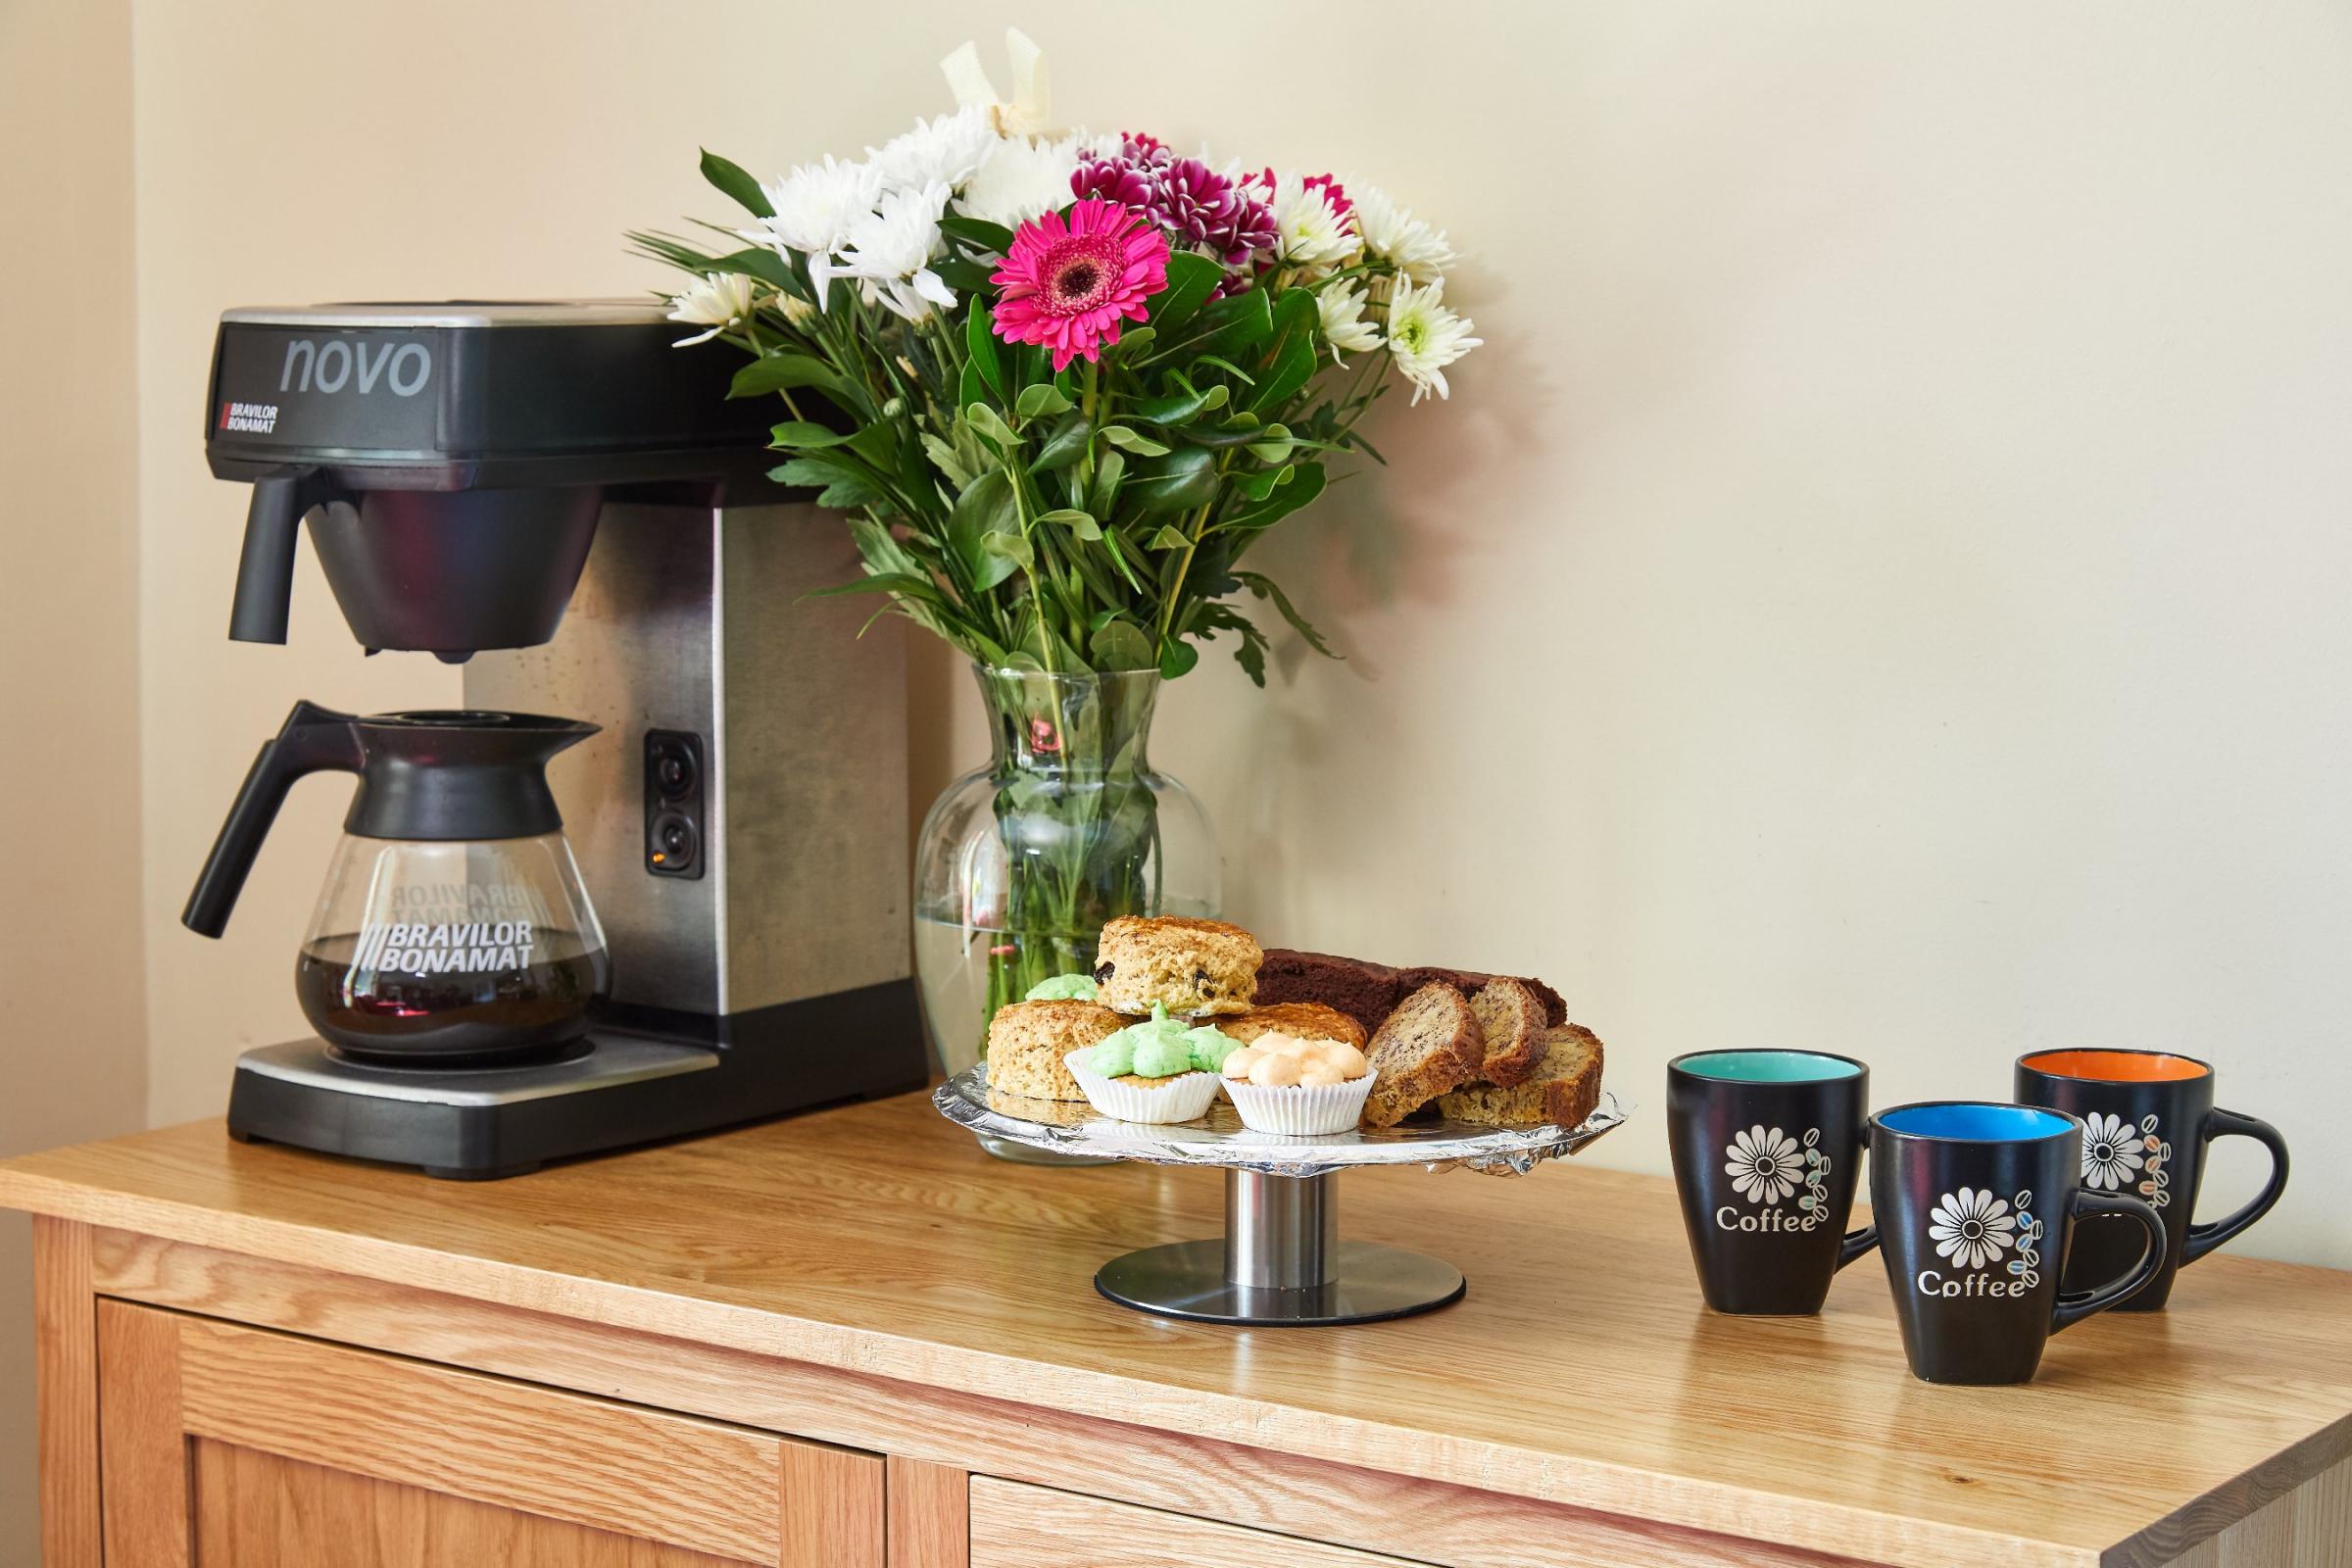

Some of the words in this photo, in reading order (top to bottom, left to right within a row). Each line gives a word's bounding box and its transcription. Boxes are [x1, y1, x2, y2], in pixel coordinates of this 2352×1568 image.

[279, 339, 432, 397] novo
[229, 402, 278, 419] BRAVILOR
[226, 416, 276, 434] BONAMAT
[387, 920, 533, 948] BRAVILOR
[378, 945, 534, 973] BONAMAT
[1716, 1205, 1817, 1233] Coffee
[1917, 1270, 2027, 1298] Coffee
